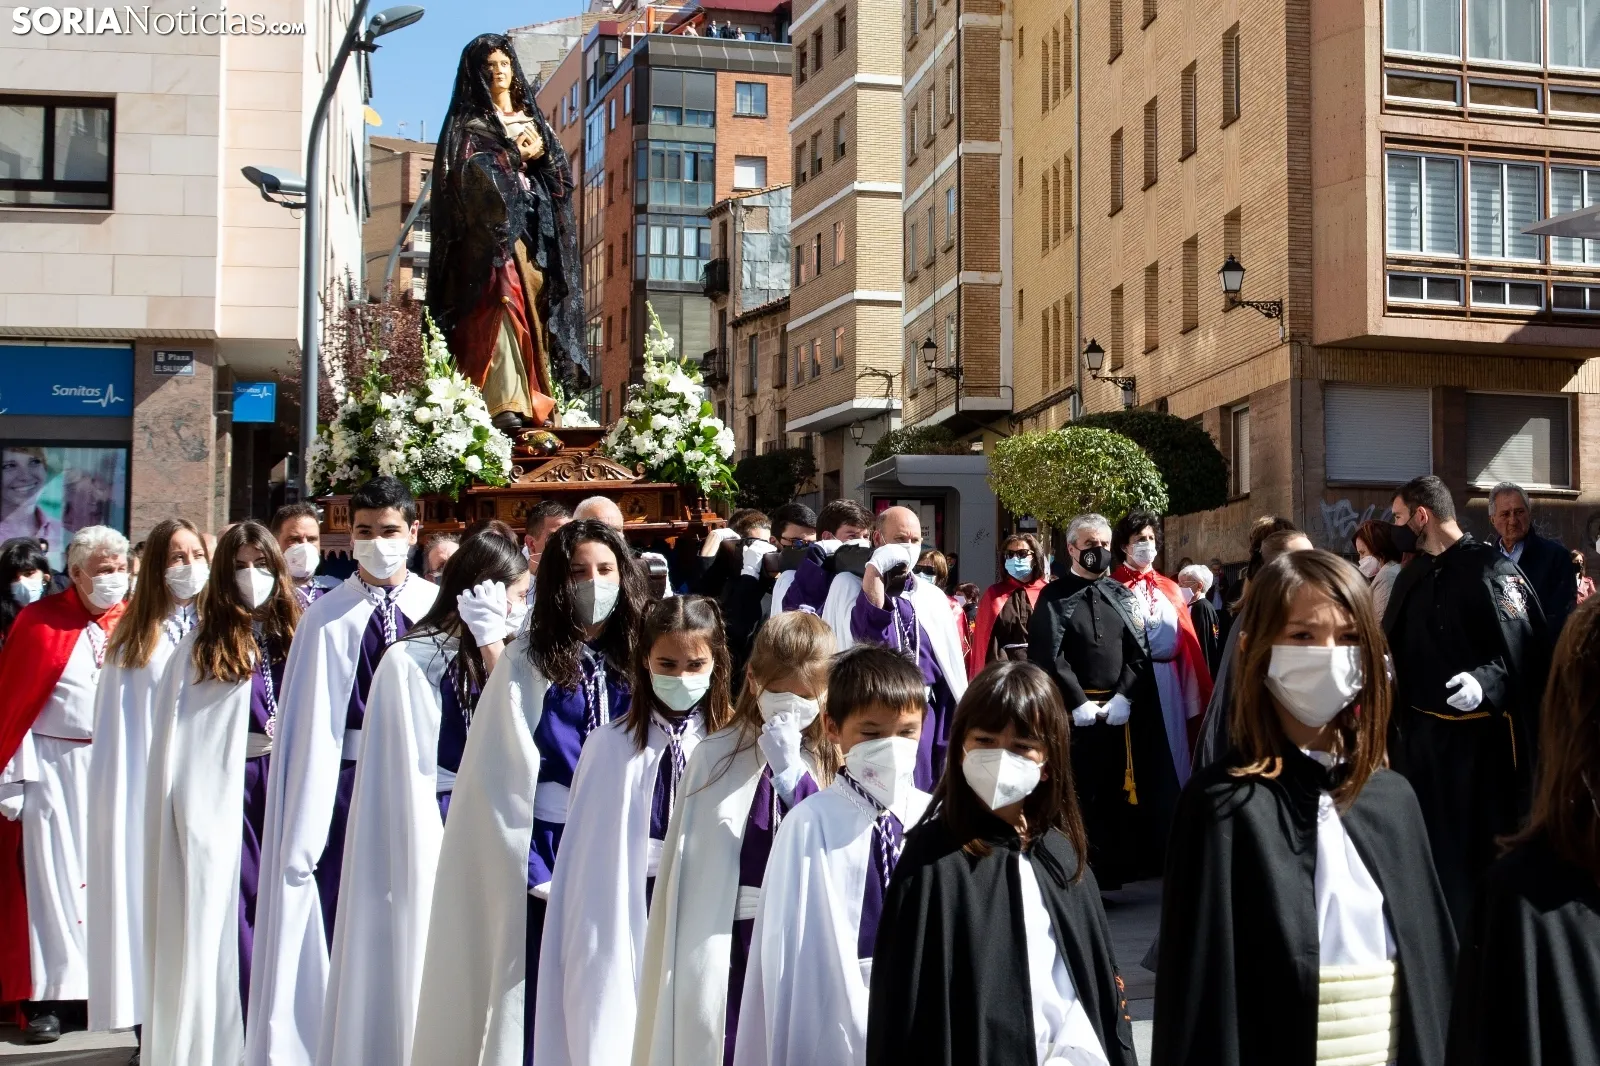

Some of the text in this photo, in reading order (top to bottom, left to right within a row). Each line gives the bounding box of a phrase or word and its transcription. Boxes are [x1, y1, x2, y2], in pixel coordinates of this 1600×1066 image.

[167, 353, 190, 361] Plaza
[52, 384, 101, 397] Sanitas
[236, 386, 261, 394] Sanitas
